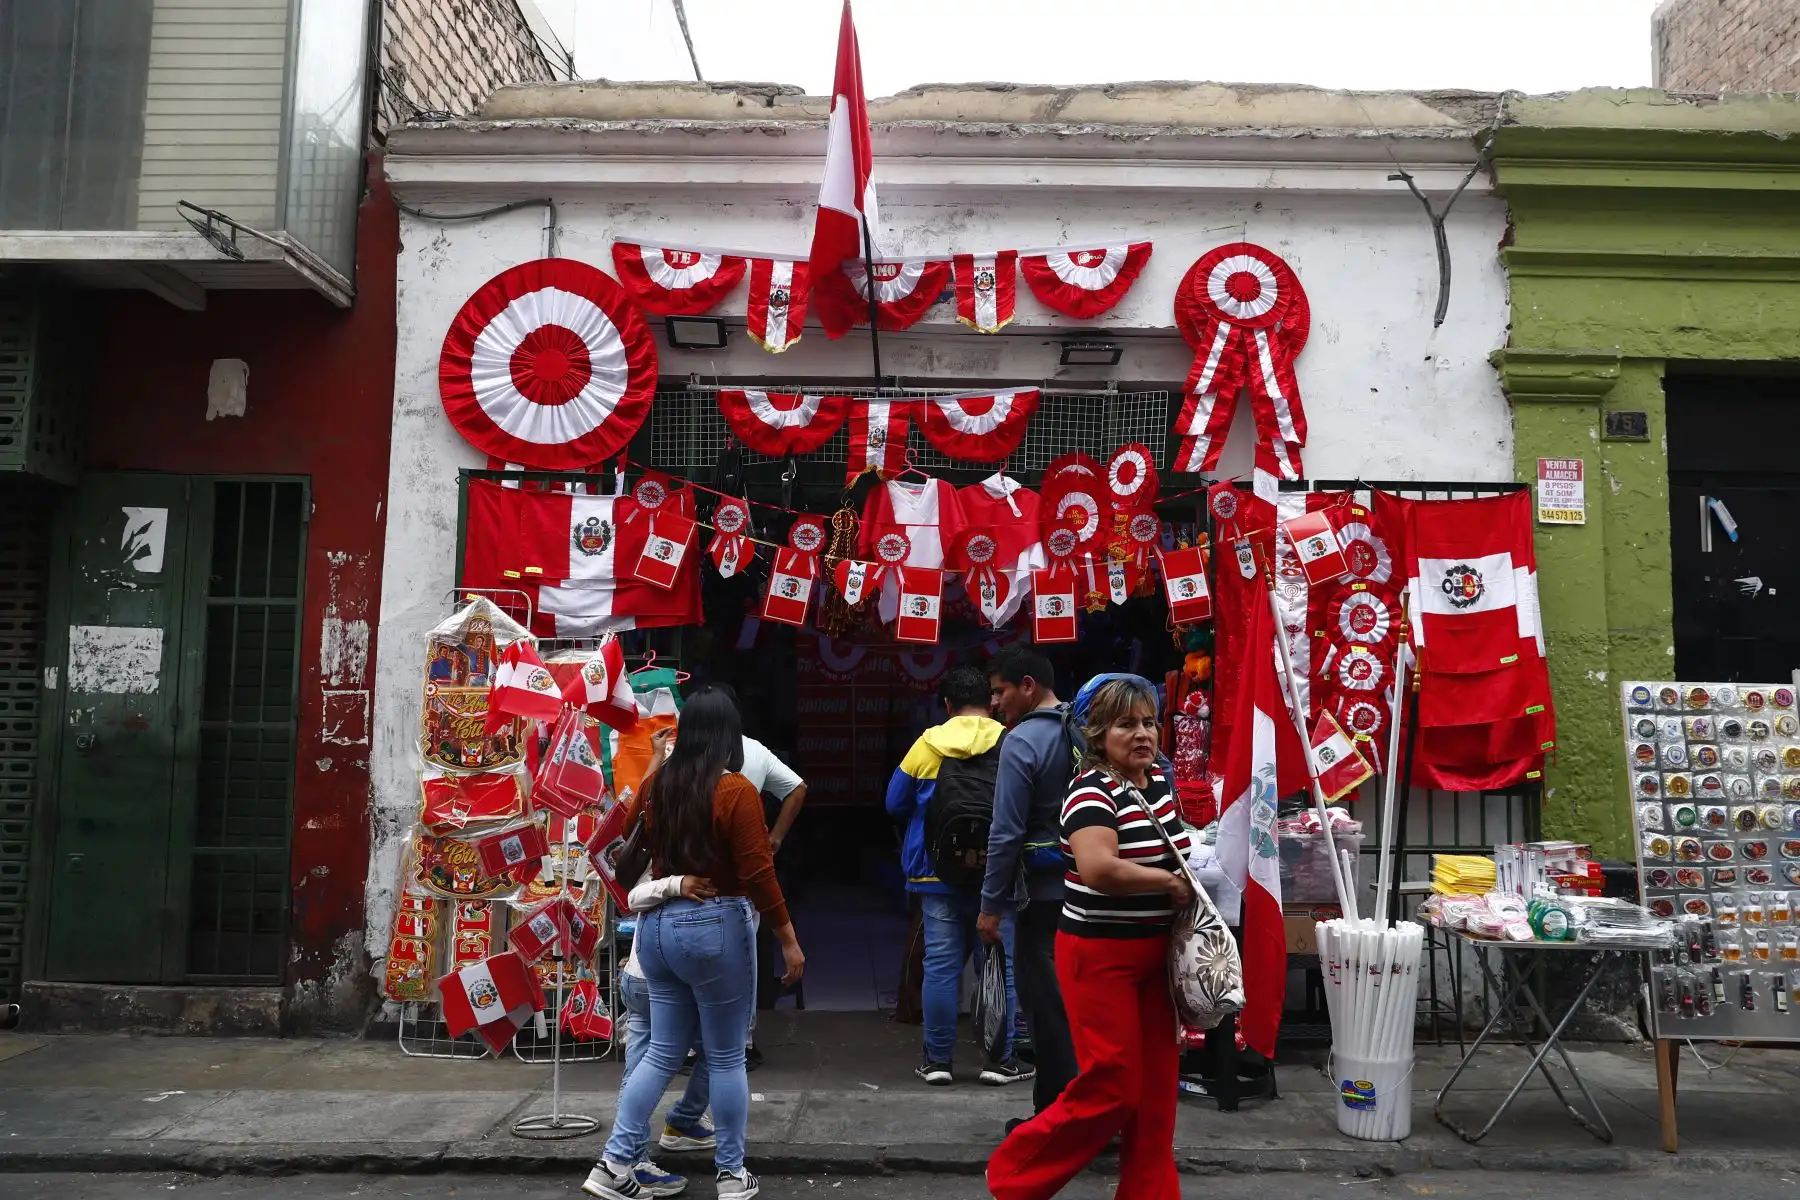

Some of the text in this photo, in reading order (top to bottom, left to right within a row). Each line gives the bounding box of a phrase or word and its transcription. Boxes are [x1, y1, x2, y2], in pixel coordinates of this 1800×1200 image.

[671, 251, 691, 264] TE
[1545, 460, 1578, 470] VENTA DE
[1545, 470, 1578, 480] ALMACEN
[1541, 510, 1583, 521] 944 573 125
